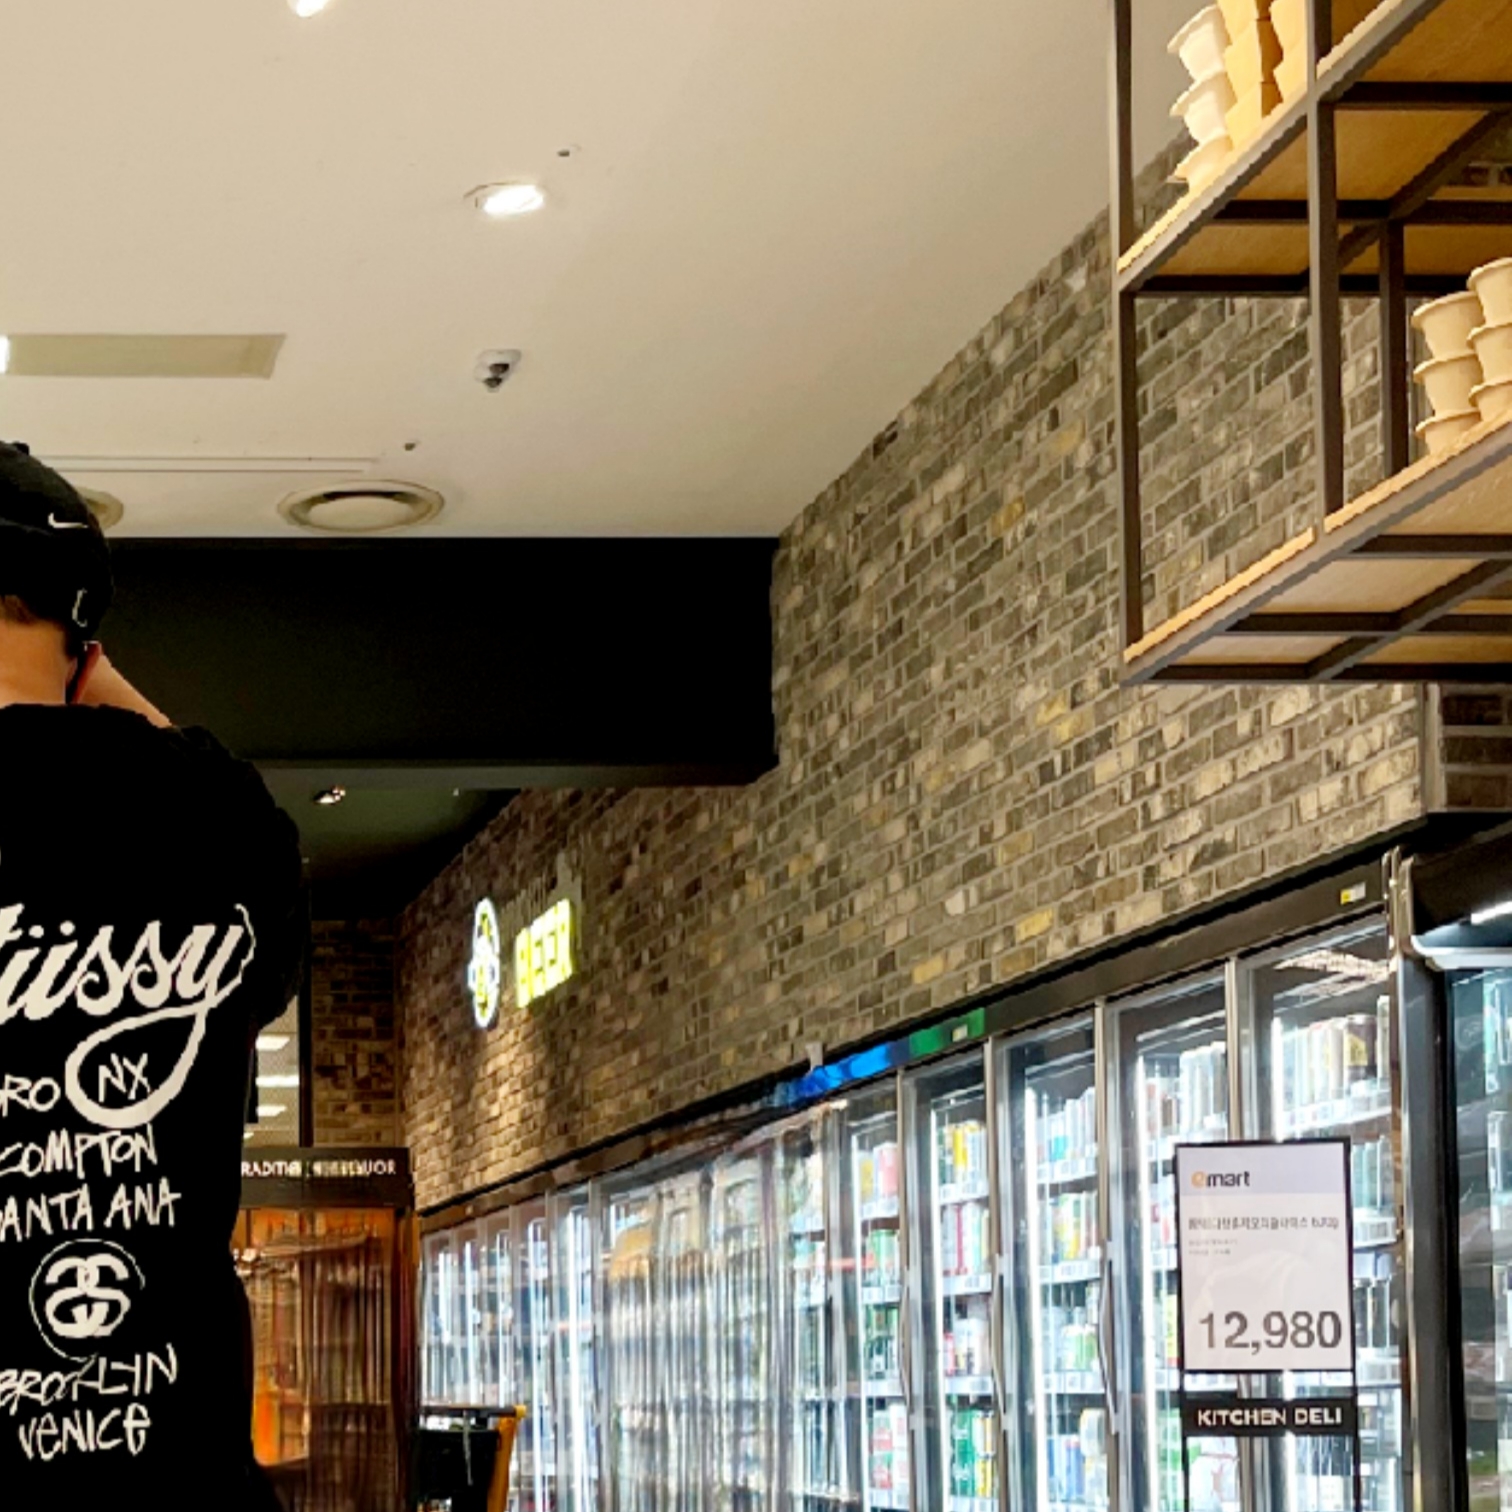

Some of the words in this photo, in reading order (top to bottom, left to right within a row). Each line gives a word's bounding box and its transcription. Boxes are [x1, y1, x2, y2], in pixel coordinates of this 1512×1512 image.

[515, 898, 572, 1008] BEER
[1191, 1171, 1251, 1189] emart
[103, 1176, 182, 1230] ANA
[1199, 1310, 1342, 1355] 12,980
[1197, 1408, 1286, 1427] KITCHEN
[1294, 1406, 1343, 1425] DELI
